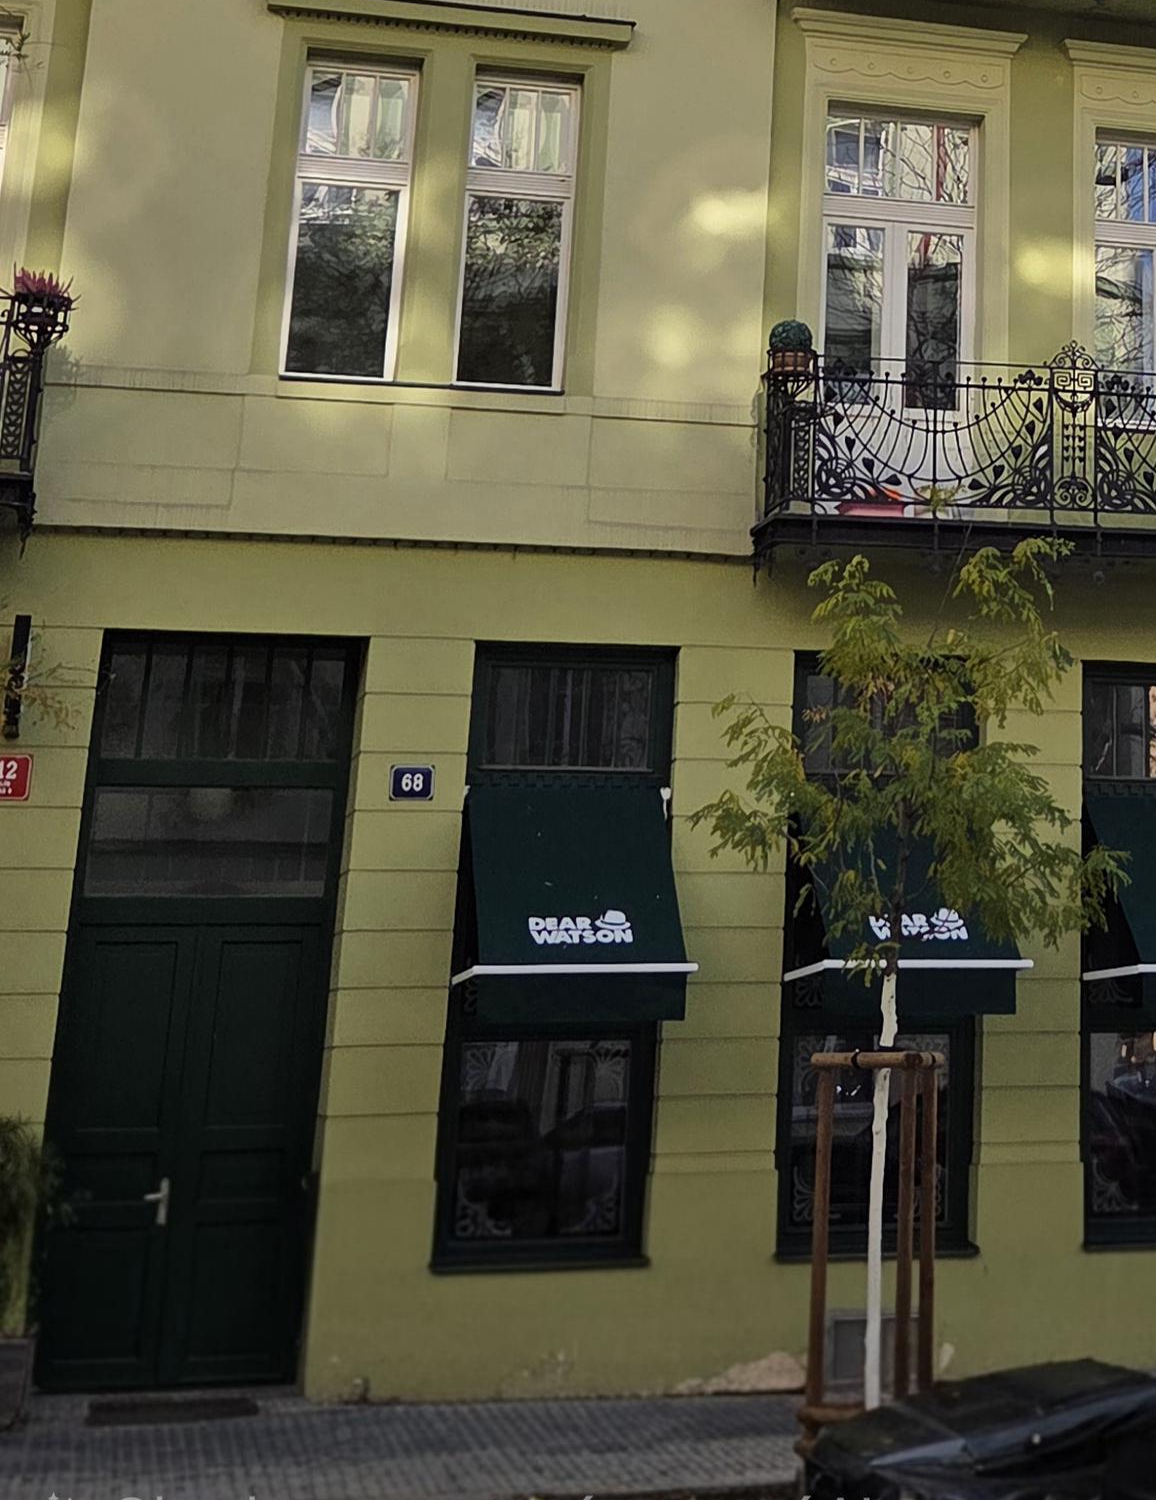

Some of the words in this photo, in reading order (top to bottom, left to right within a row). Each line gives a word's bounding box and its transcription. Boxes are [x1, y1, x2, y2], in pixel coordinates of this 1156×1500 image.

[401, 773, 424, 792] 68
[528, 917, 592, 931] DEAR
[530, 929, 634, 945] WATSON
